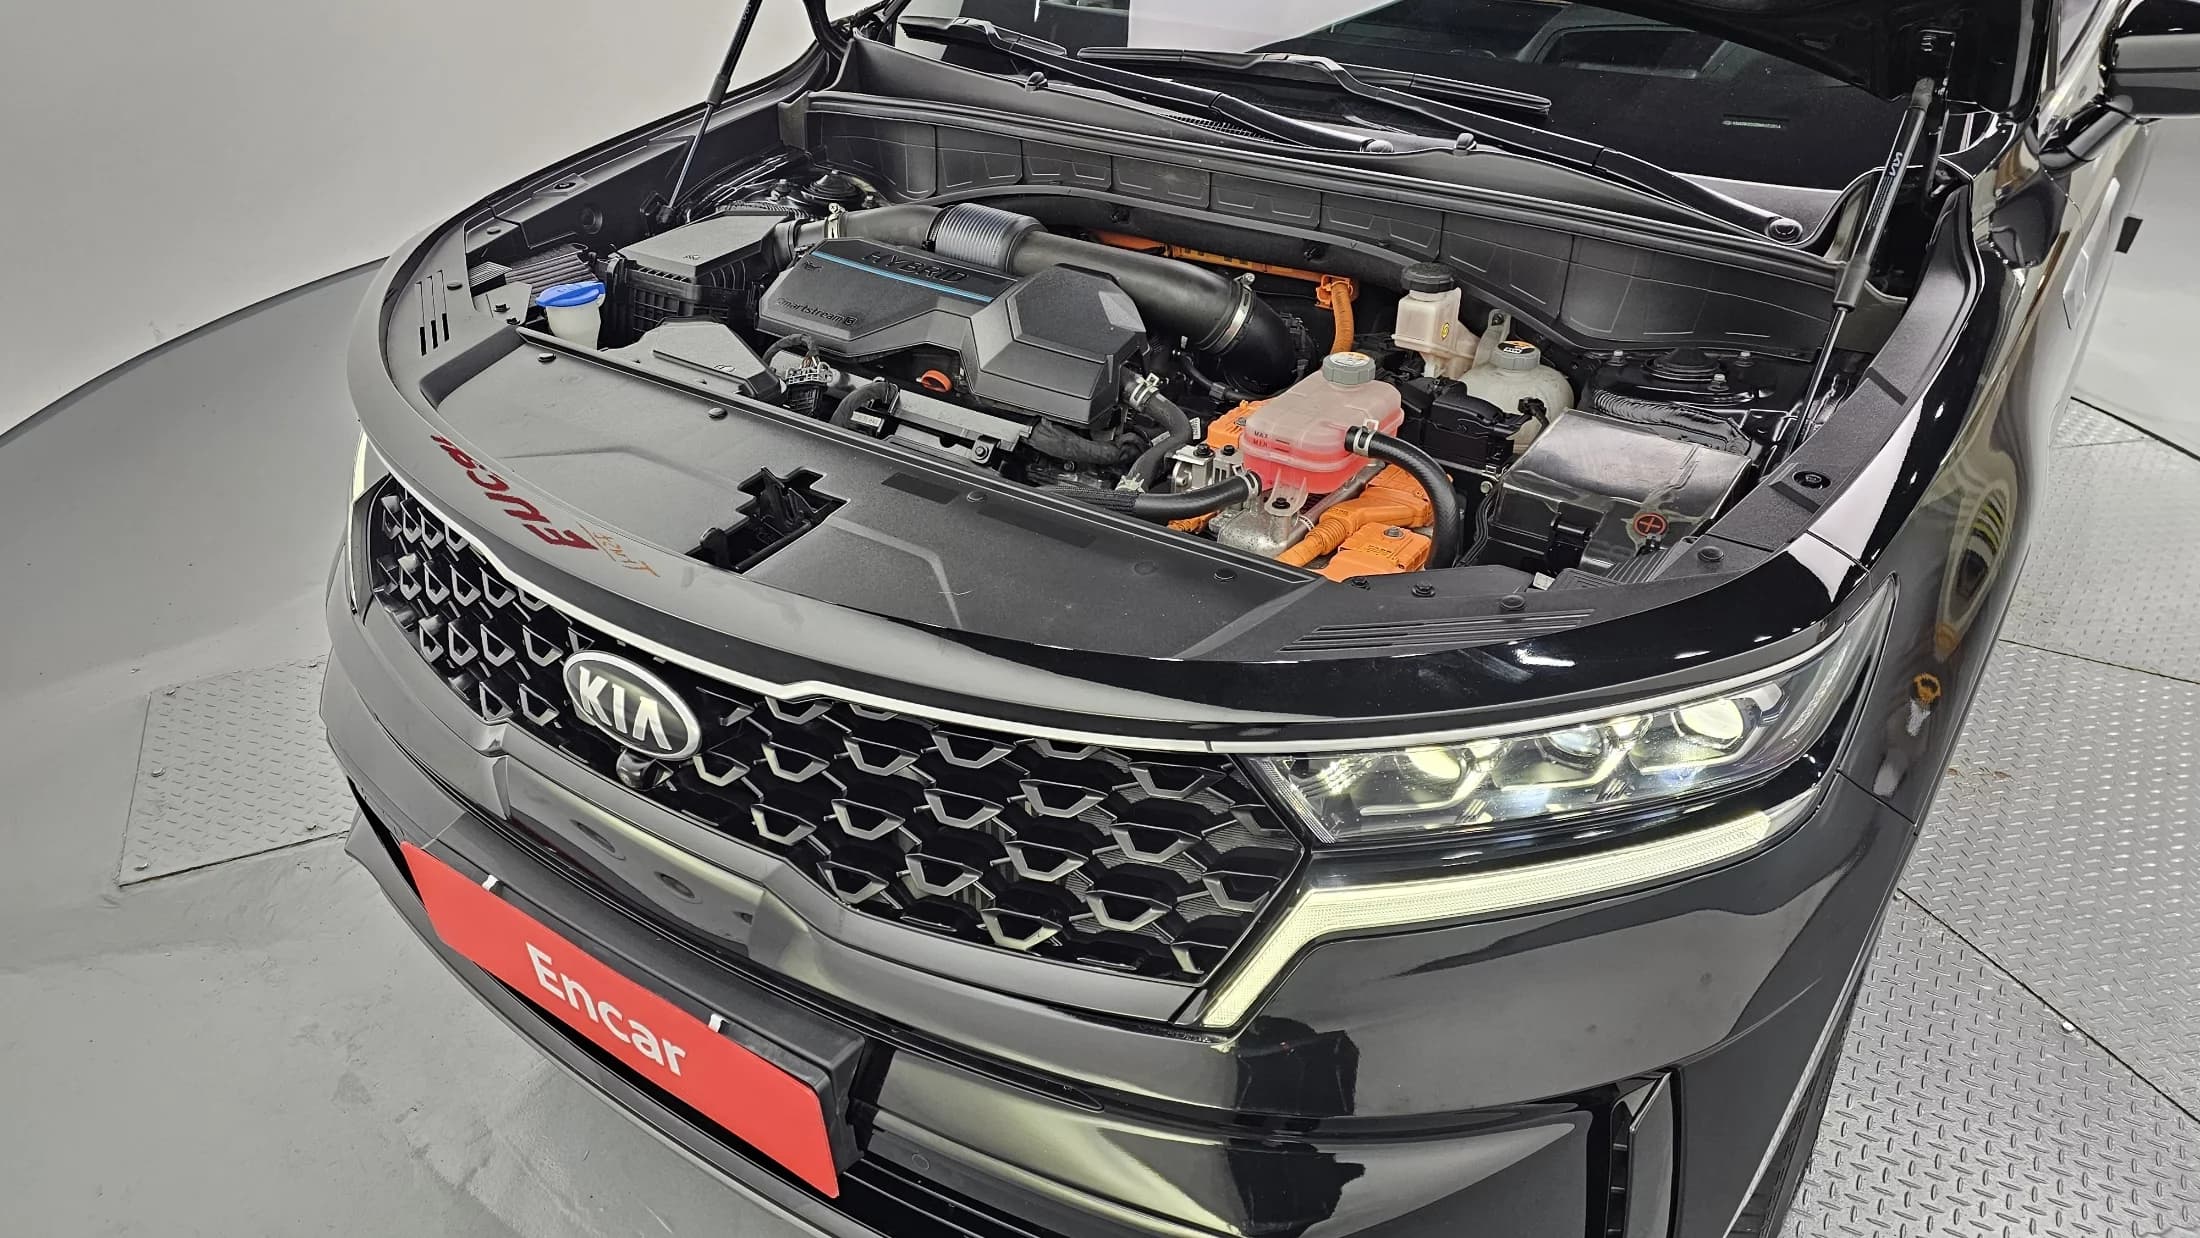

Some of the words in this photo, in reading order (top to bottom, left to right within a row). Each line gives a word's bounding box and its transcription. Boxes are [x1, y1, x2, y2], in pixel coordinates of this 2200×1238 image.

[860, 250, 969, 283] HYBRID
[1253, 439, 1268, 448] MIN
[1254, 430, 1269, 439] MAX
[579, 665, 673, 751] KIA
[526, 941, 687, 1077] Encar
